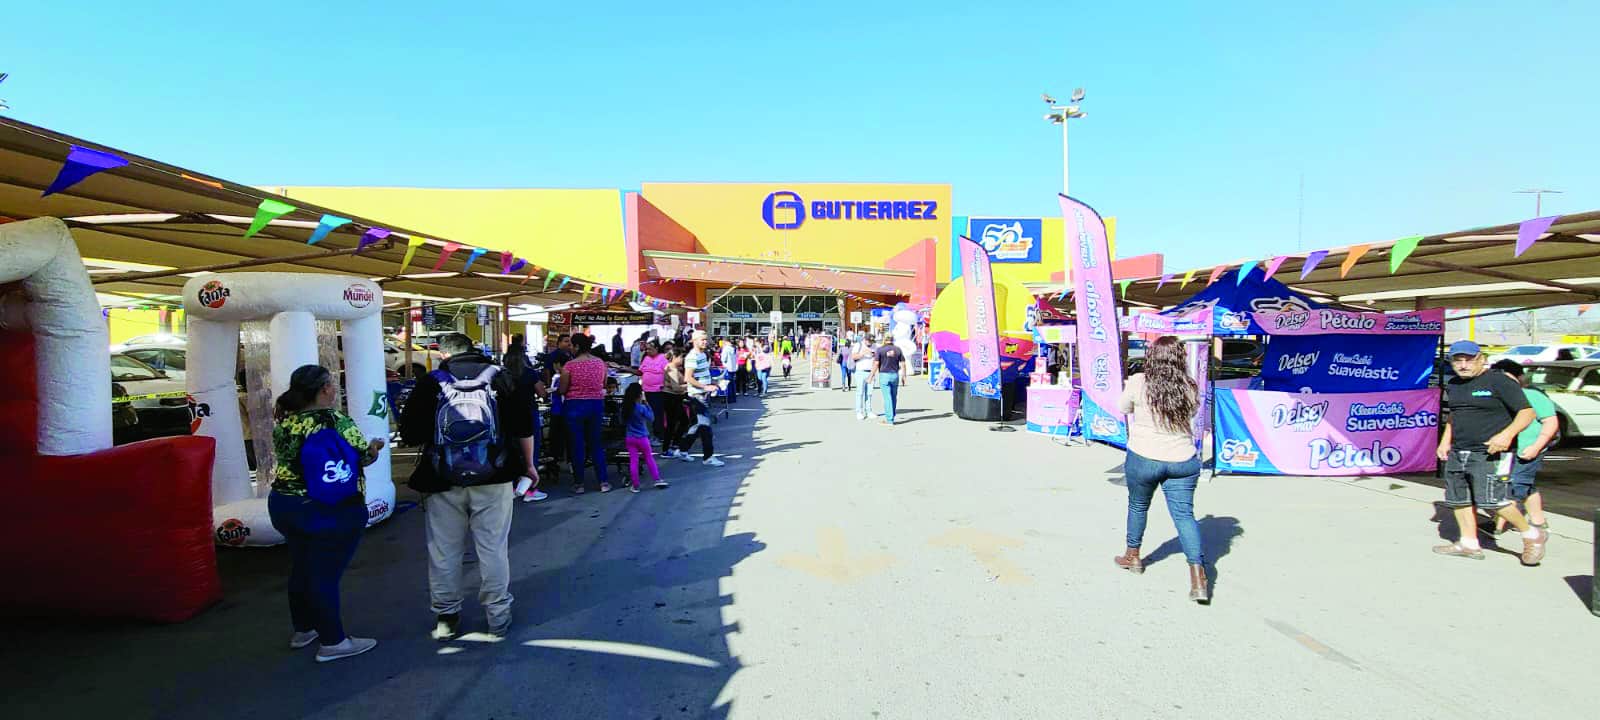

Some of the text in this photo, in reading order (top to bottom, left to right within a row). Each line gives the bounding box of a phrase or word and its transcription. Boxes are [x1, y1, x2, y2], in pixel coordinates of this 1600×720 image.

[811, 201, 938, 220] GUTIERREZ
[1275, 311, 1310, 330] Delsey
[1320, 309, 1376, 329] Pétalo
[1278, 350, 1320, 372] Delsey
[1327, 363, 1400, 381] Suavelastic
[1271, 401, 1329, 429] Delsey
[1346, 411, 1438, 432] Suavelastic
[1308, 438, 1402, 470] Pétalo
